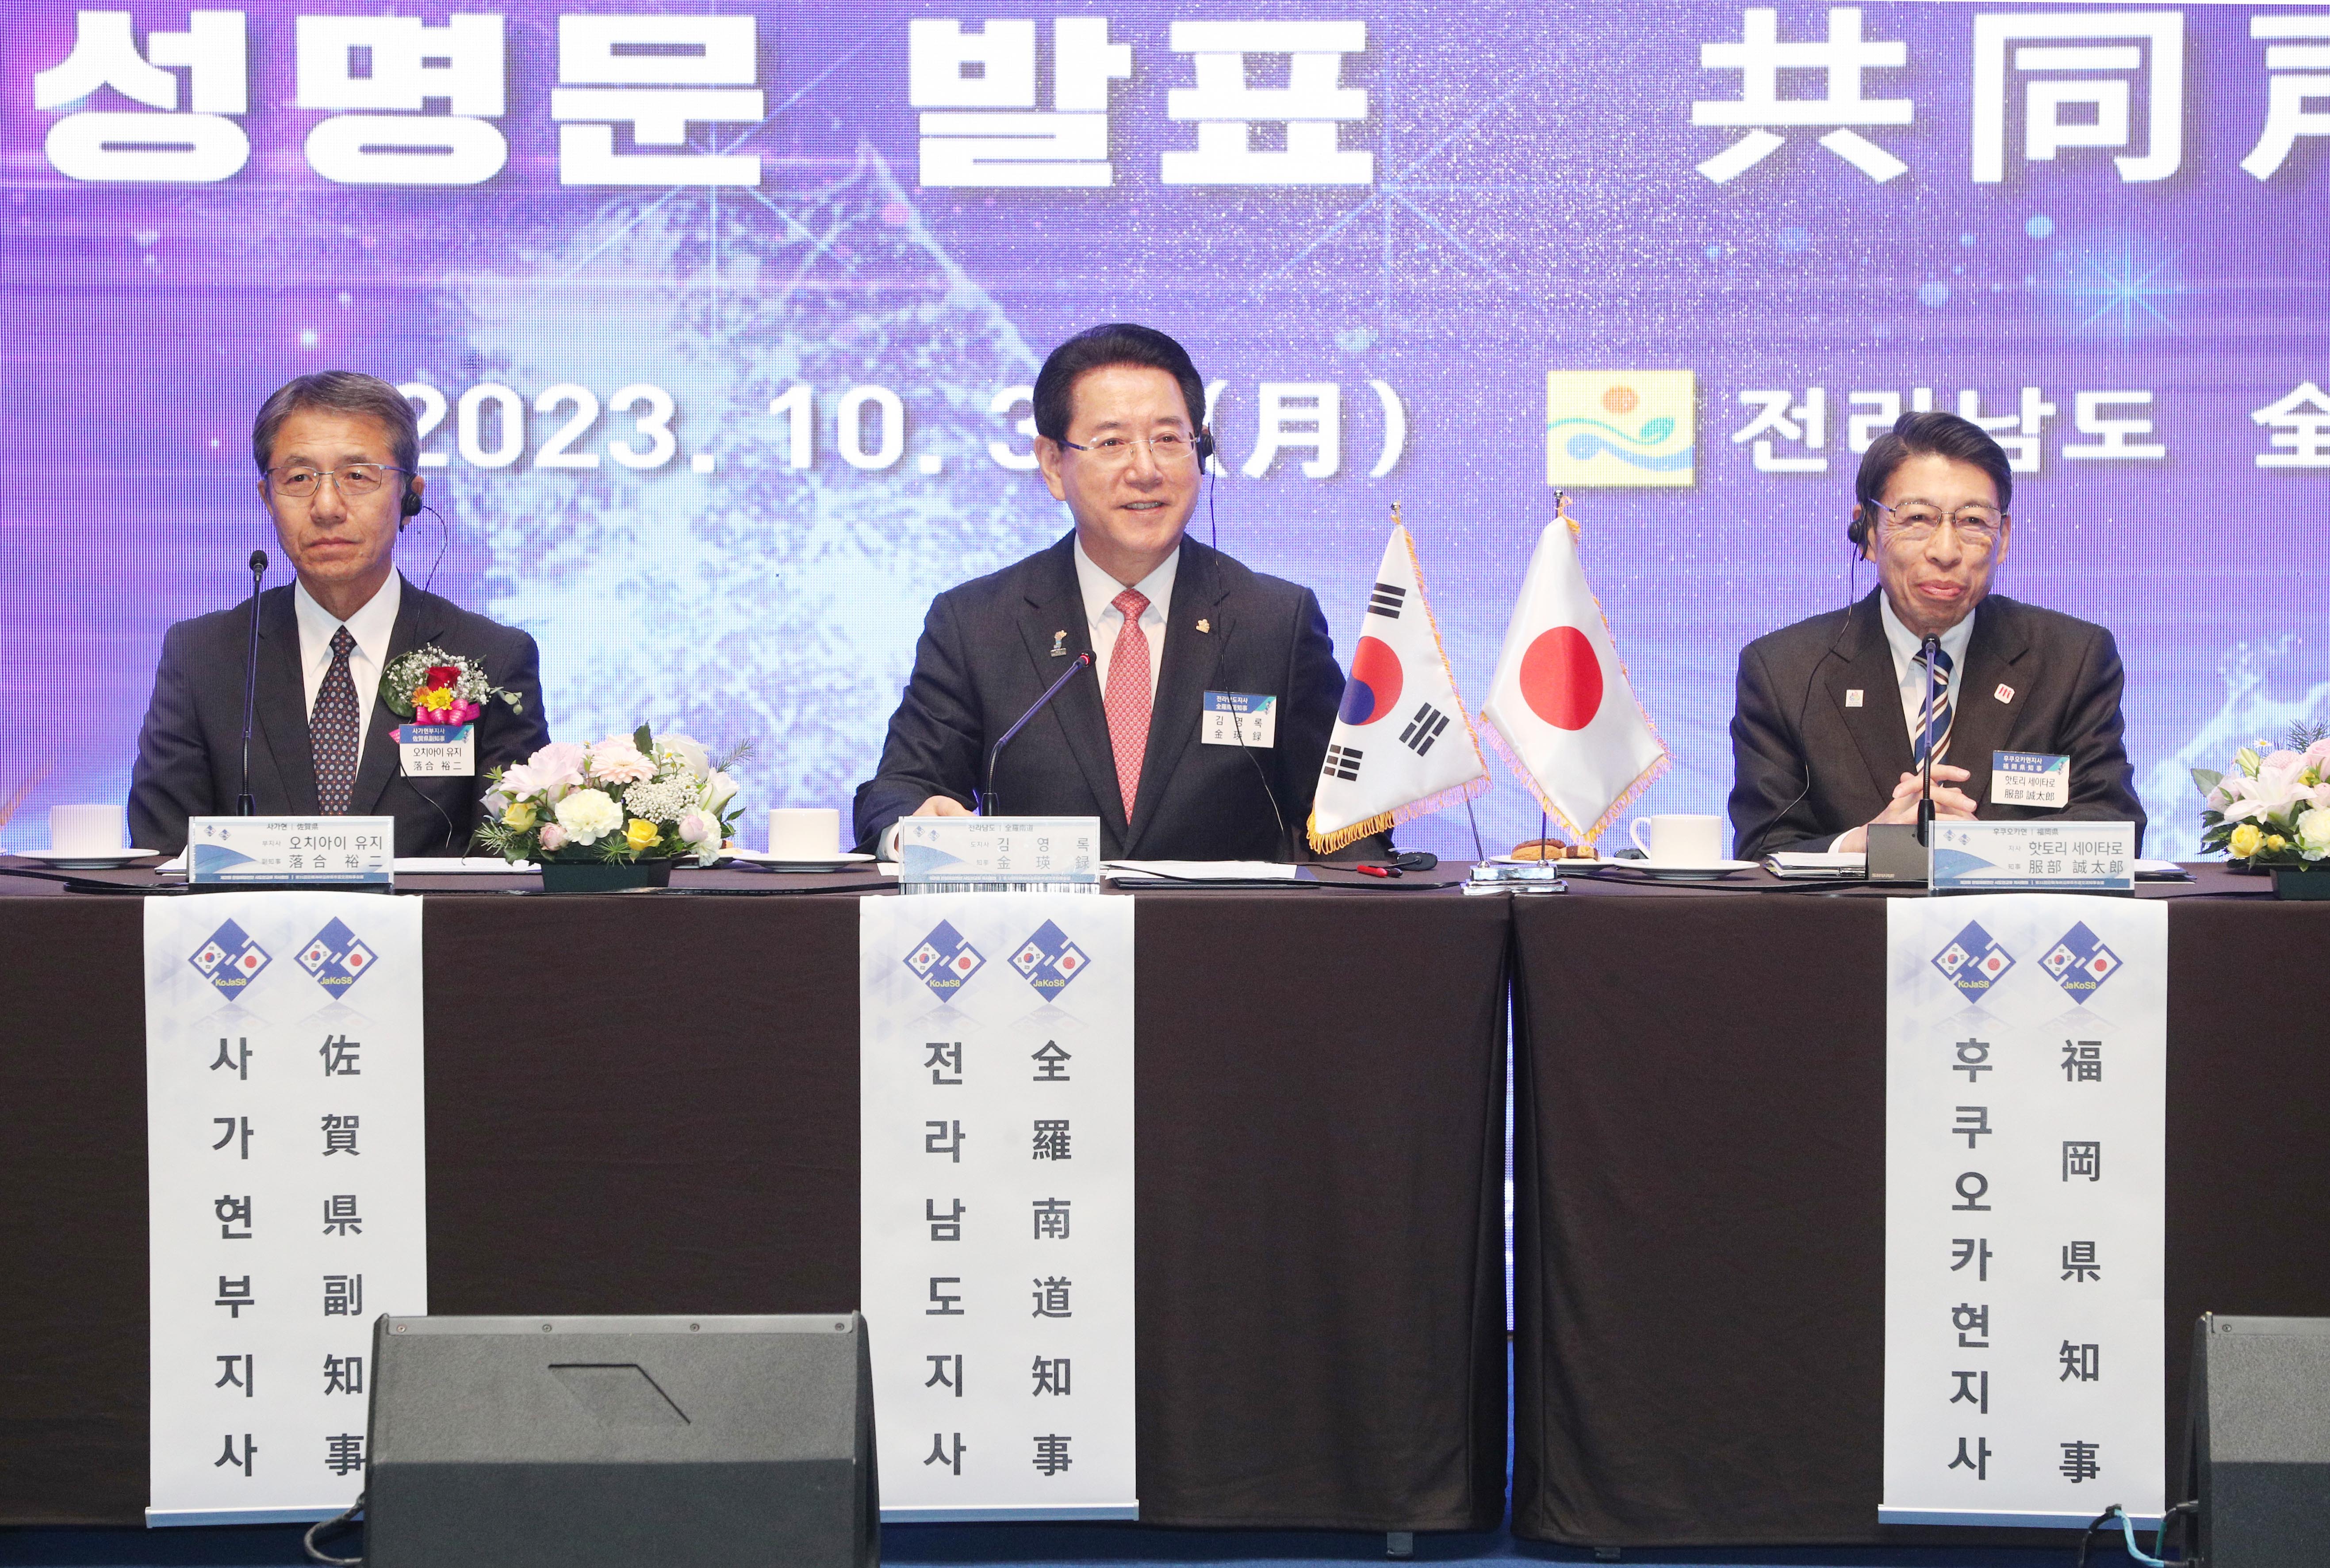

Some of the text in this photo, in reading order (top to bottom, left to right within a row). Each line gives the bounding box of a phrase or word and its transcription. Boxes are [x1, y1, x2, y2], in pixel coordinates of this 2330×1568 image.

[34, 10, 1374, 186] 성명문 발표
[395, 382, 714, 473] 2023.
[770, 385, 943, 474] 10.
[413, 747, 461, 757] 오치아이 유지
[2004, 755, 2042, 764] 후쿠오카현지사
[2005, 775, 2055, 788] 핫토리 세이타로
[289, 836, 346, 850] 오치아이
[355, 836, 383, 850] 유지
[2029, 841, 2067, 856] 핫토리
[2072, 841, 2123, 856] 세이타로
[215, 978, 247, 987] KoJaS8
[320, 976, 353, 985] JaKoS8
[929, 979, 961, 988] KoJaS8
[1033, 979, 1065, 988] JaKoS8
[1958, 980, 1990, 989] KoJaS8
[2063, 981, 2096, 990] JaKoS8
[209, 1037, 257, 1477] 사가현부지사
[319, 1034, 366, 1476] 佐賀県副知事
[923, 1042, 966, 1476] 전라남도지사
[1031, 1040, 1073, 1476] 全羅南道知事
[1948, 1037, 1993, 1481] 후쿠오카현지사
[2059, 1039, 2102, 1483] 福岡県知事
